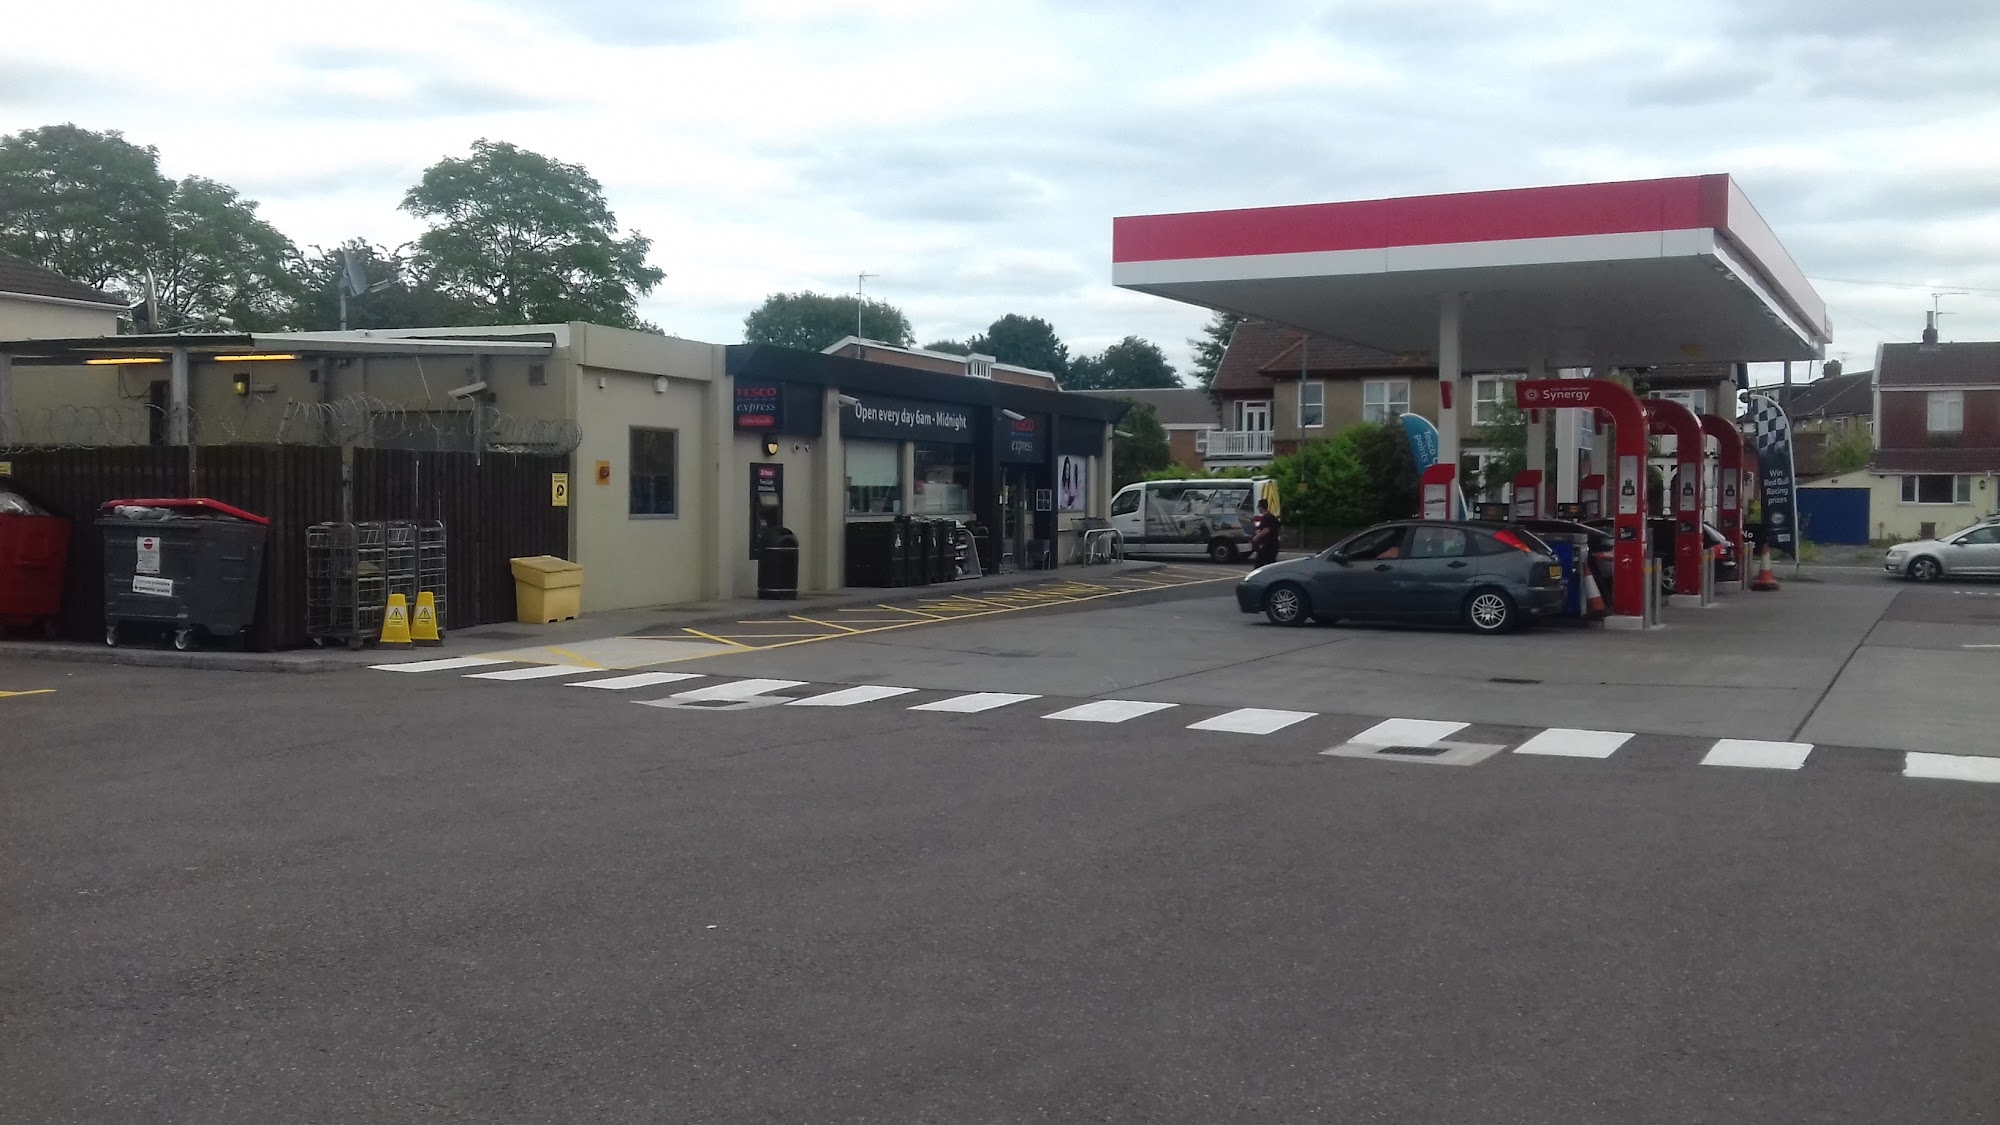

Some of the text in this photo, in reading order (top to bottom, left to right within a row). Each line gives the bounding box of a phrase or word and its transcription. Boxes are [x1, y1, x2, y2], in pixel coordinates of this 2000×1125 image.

[735, 387, 777, 397] TESCO
[1543, 389, 1590, 401] Synergy
[736, 403, 775, 414] express
[855, 402, 877, 423] Open
[878, 409, 900, 426] every
[901, 408, 915, 427] day
[915, 410, 931, 425] 6am
[936, 412, 967, 431] Midnight
[1011, 441, 1033, 455] express
[1424, 430, 1436, 455] Tesco
[1414, 434, 1429, 463] points
[1764, 479, 1777, 487] Red
[1766, 488, 1789, 496] Racing
[1768, 498, 1788, 506] prizes
